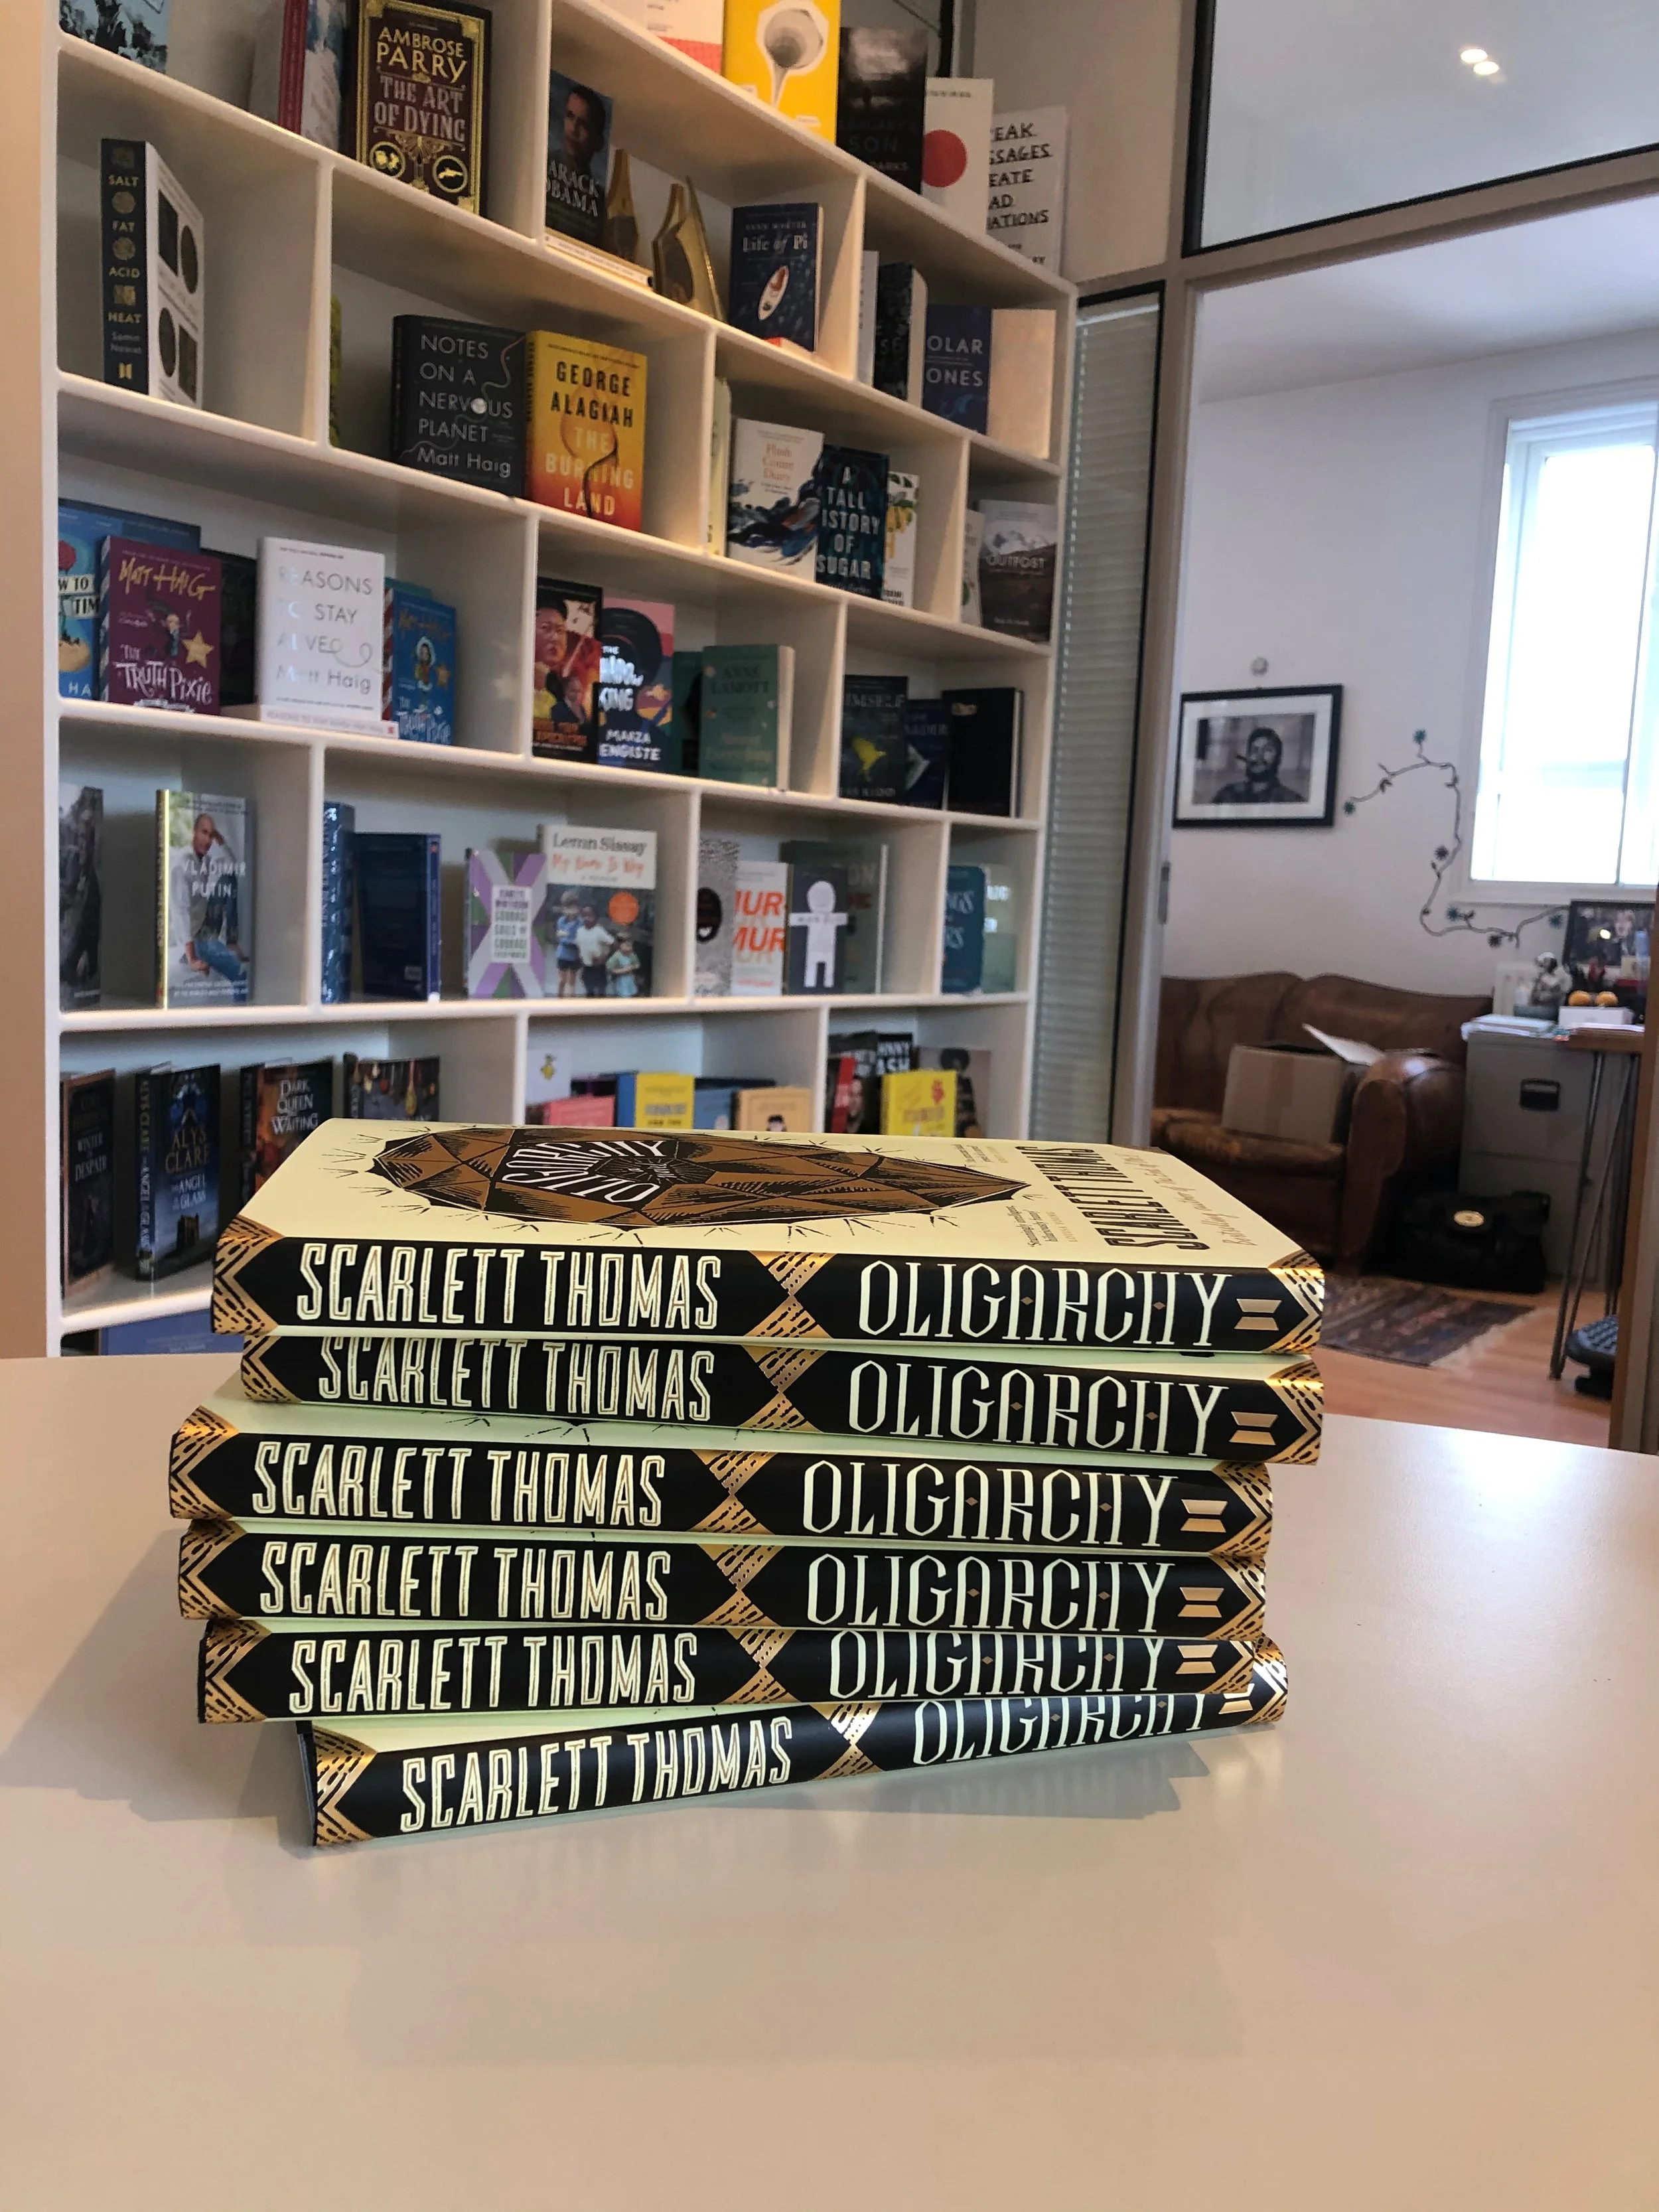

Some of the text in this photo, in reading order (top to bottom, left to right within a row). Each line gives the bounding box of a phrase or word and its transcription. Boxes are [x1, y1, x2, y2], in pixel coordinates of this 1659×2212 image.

[379, 27, 464, 58] AMBROSE
[376, 42, 467, 83] PARRY
[380, 75, 463, 115] THE ART
[375, 101, 465, 142] OF DYING
[991, 123, 1037, 141] EAK
[108, 175, 139, 186] SALT
[549, 160, 599, 198] ARACK
[989, 169, 1035, 186] EATE
[988, 194, 1015, 210] AD
[112, 221, 135, 232] FAT
[743, 234, 770, 252] Life
[793, 231, 808, 250] Pi
[109, 267, 141, 278] ACID
[108, 313, 141, 324] HEAT
[420, 334, 488, 359] NOTES
[926, 335, 983, 354] OLAR
[419, 362, 476, 386] ON A
[556, 361, 630, 396] GEORGE
[926, 368, 983, 386] ONES
[419, 390, 513, 419] NERVOUS
[551, 390, 633, 427] ALAGIAH
[419, 418, 489, 443] PLANET
[575, 427, 610, 452] THE
[417, 447, 511, 479] Matt Haig
[545, 453, 634, 490] BURNING
[841, 467, 851, 484] A
[564, 487, 615, 516] LAND
[828, 486, 865, 510] TALL
[822, 509, 881, 535] ISTORY
[833, 534, 855, 553] OF
[816, 554, 872, 579] SUGAR
[74, 577, 90, 590] TO
[73, 599, 100, 615] TIM
[314, 603, 358, 625] STAY
[68, 683, 92, 696] HA
[113, 660, 167, 697] TRUTH
[328, 669, 372, 696] Haig
[605, 729, 652, 744] MAAZA
[599, 743, 661, 761] ENGISTE
[184, 860, 246, 877] VLADIMIR
[192, 881, 232, 899] PUTIN
[281, 1078, 311, 1099] DARK
[271, 1112, 319, 1136] WAITING
[172, 1124, 207, 1151] ALYS
[166, 1143, 210, 1174] CLARE
[1015, 1145, 1210, 1250] SCARLETT THOMAS
[297, 1243, 1232, 1347] SCARLETT THOMAS OLIGARCHY
[319, 1337, 1229, 1456] SCARLETT THOMAS OLIGARCHY
[253, 1441, 1179, 1546] SCARLETT THOMAS OLIGARCHY
[259, 1540, 1175, 1633] SCARLETT THOMAS OLIGARCHY
[289, 1630, 1168, 1714] SCARLETT THOMAS OLIGARCHY
[401, 1733, 613, 1832] SCARLETT
[627, 1716, 794, 1803] THOMAS
